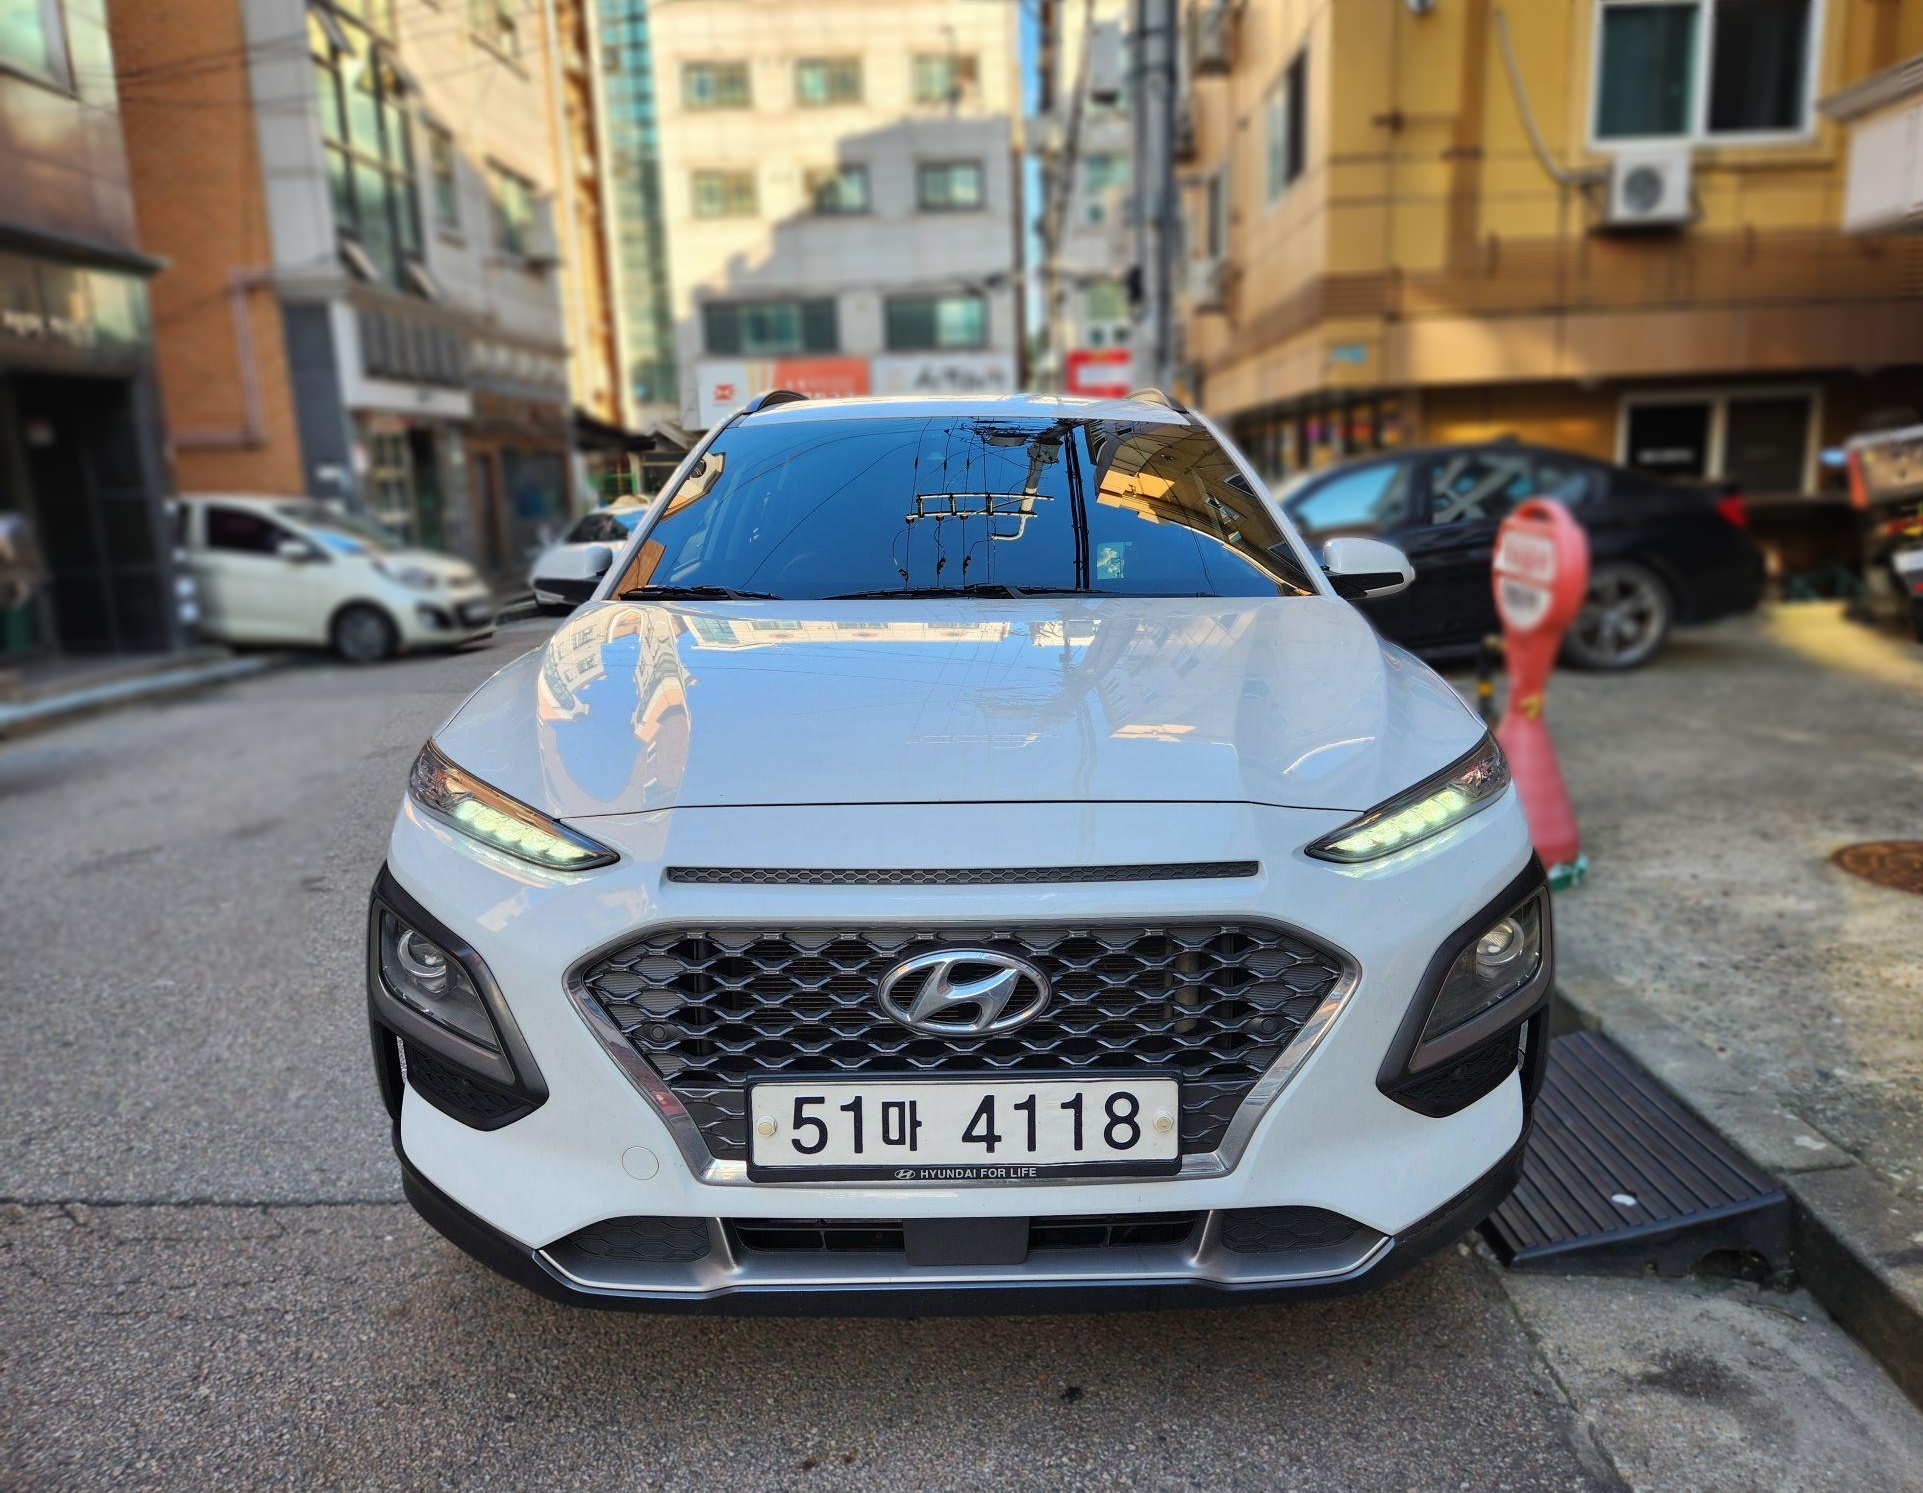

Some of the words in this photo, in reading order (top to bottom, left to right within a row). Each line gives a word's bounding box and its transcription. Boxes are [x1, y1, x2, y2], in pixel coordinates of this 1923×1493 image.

[791, 1095, 923, 1155] 51마
[961, 1091, 1141, 1154] 4118
[920, 1168, 977, 1179] HYUNDAI
[980, 1168, 1006, 1178] FOR
[1010, 1167, 1037, 1178] LIFE
